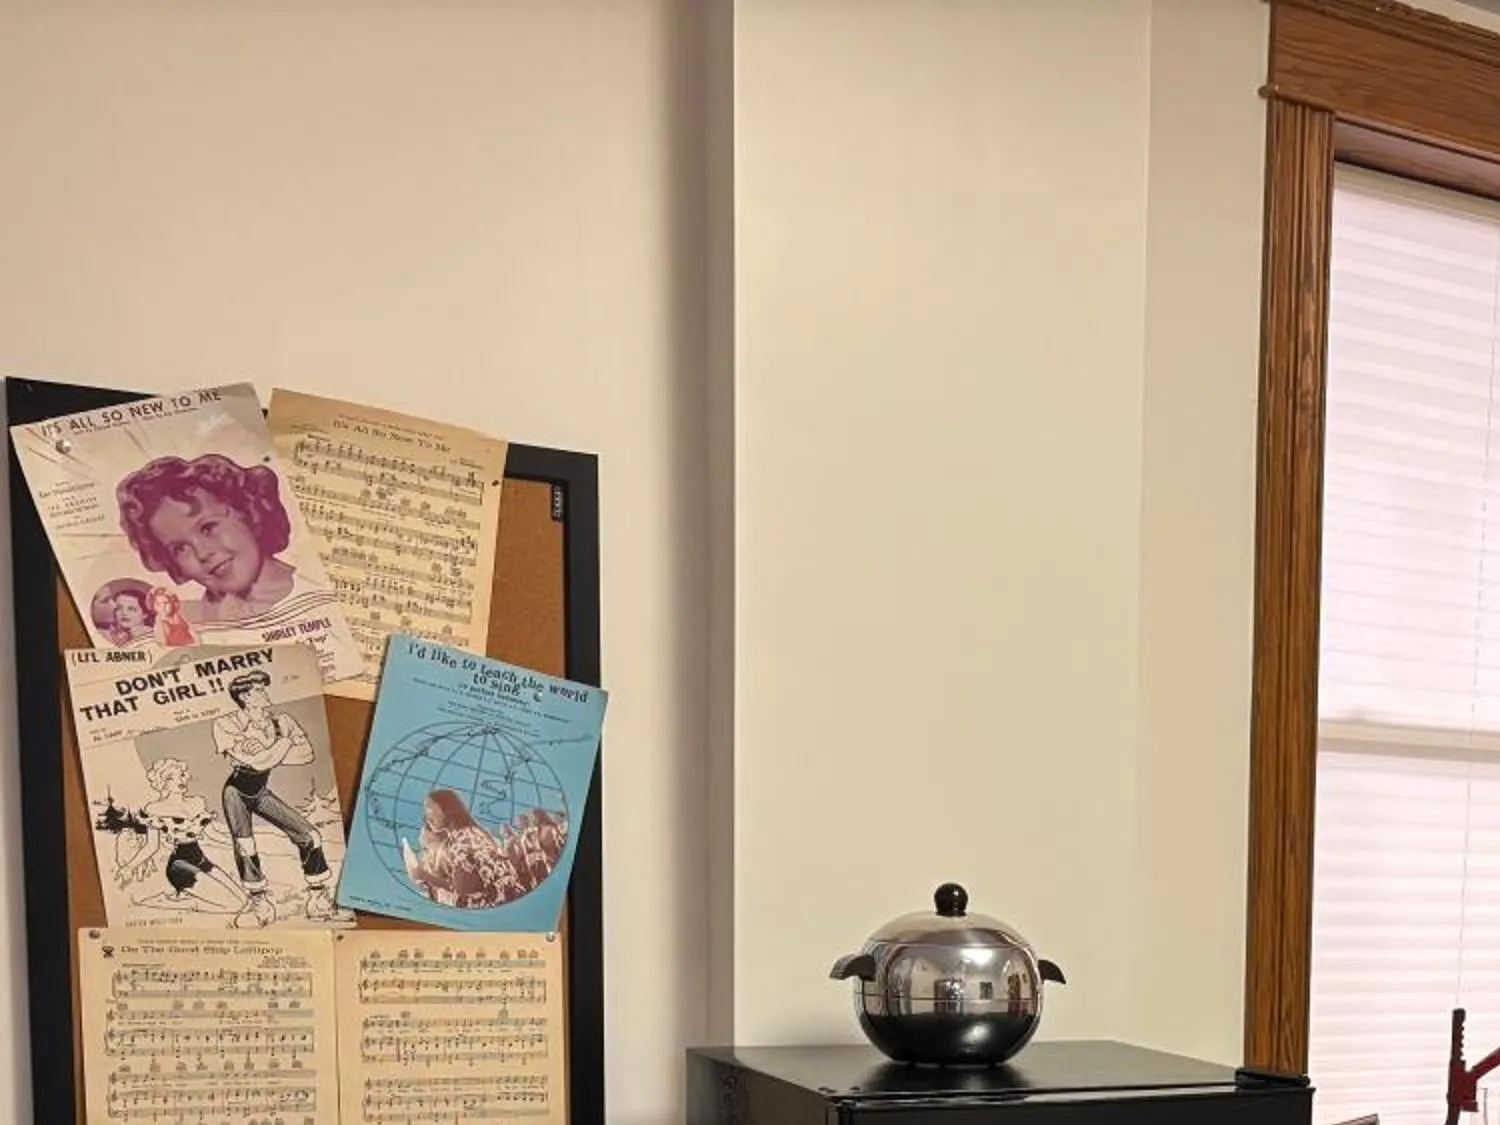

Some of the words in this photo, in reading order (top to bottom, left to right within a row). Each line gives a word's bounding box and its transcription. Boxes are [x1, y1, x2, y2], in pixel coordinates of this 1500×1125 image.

[69, 417, 94, 431] ALL
[102, 410, 123, 423] SO
[129, 402, 163, 417] NEW
[171, 395, 191, 408] TO
[199, 390, 222, 405] ME
[115, 668, 181, 696] DON'T
[195, 648, 274, 678] MARRY
[430, 649, 458, 669] like
[461, 658, 477, 672] to
[480, 663, 518, 684] teach
[521, 676, 545, 693] the
[549, 685, 589, 703] world
[473, 672, 488, 686] to
[489, 678, 522, 698] sing
[80, 695, 139, 721] THAT
